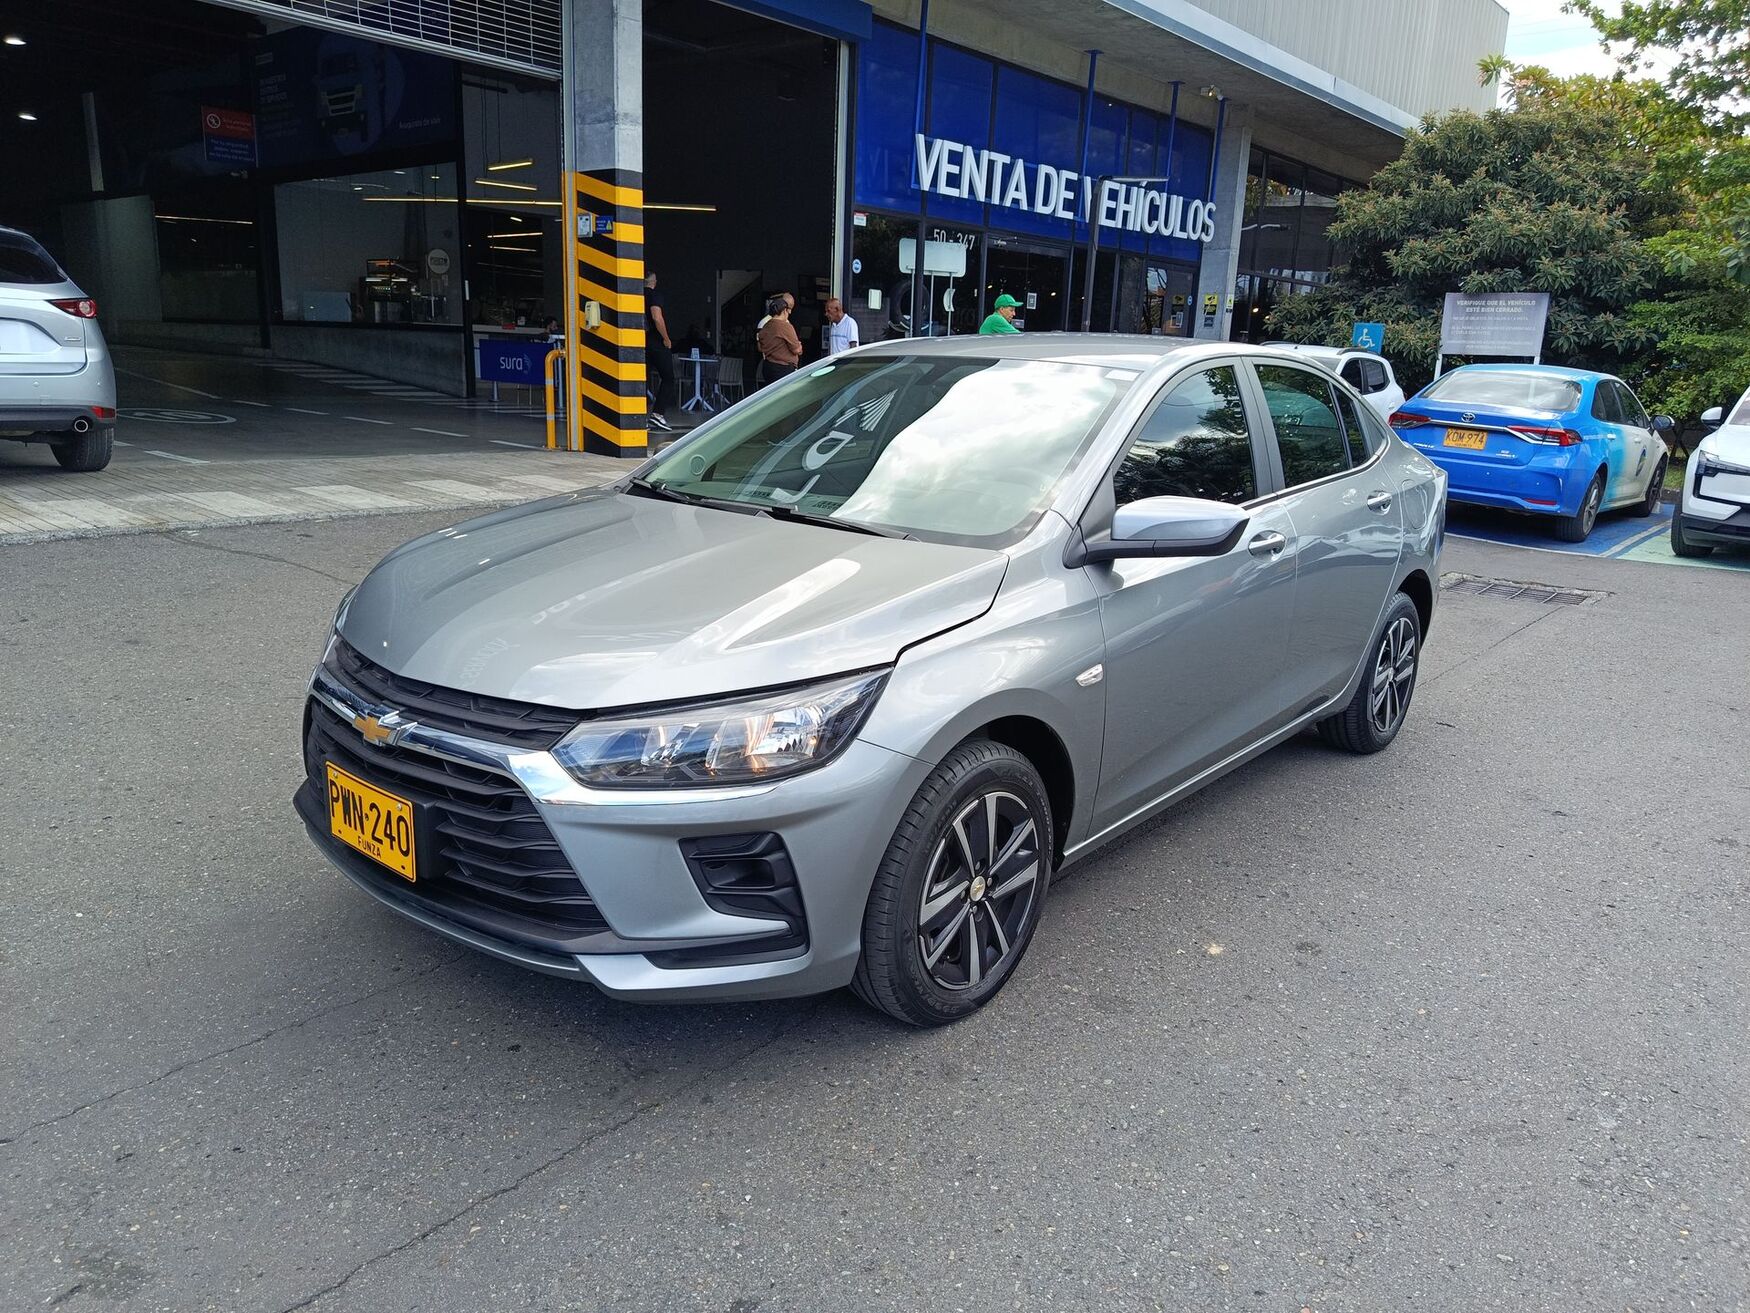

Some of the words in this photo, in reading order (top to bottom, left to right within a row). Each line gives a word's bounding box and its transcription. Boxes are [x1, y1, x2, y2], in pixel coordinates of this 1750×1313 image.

[915, 133, 1028, 211] VENTA
[1034, 164, 1079, 220] DE
[499, 356, 523, 371] sura
[329, 778, 365, 836] PWN
[368, 802, 411, 857] 240
[357, 835, 382, 859] FUNZA
